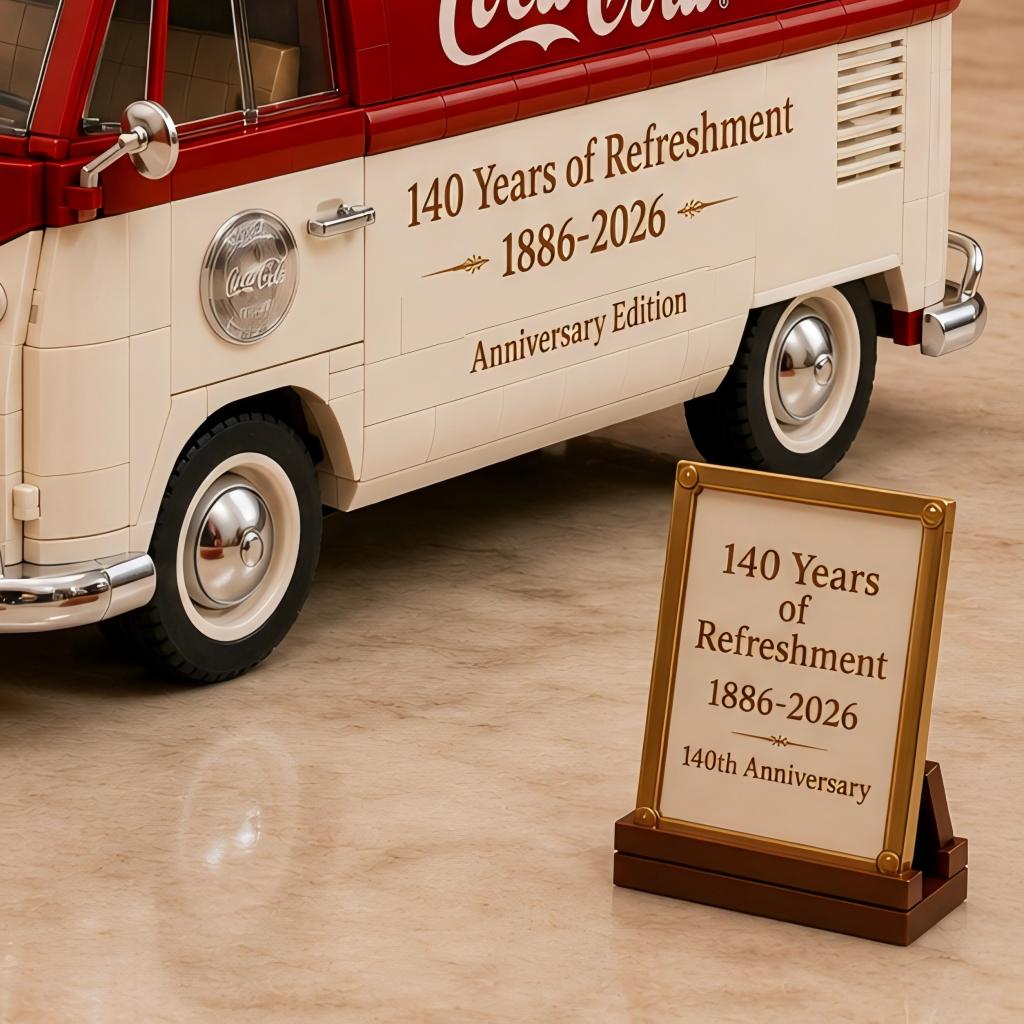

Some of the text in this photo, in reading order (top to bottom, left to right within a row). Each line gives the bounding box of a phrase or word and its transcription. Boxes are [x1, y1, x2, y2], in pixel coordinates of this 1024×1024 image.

[407, 97, 794, 228] 140 Years of Refreshment
[501, 193, 667, 278] 1886-2026
[469, 291, 688, 374] Anniversary Edition
[722, 543, 880, 596] 140 Years
[778, 594, 813, 625] of
[694, 618, 888, 680] Refreshment
[707, 678, 858, 730] 1886-2026
[682, 745, 872, 806] 140th Anniversary
